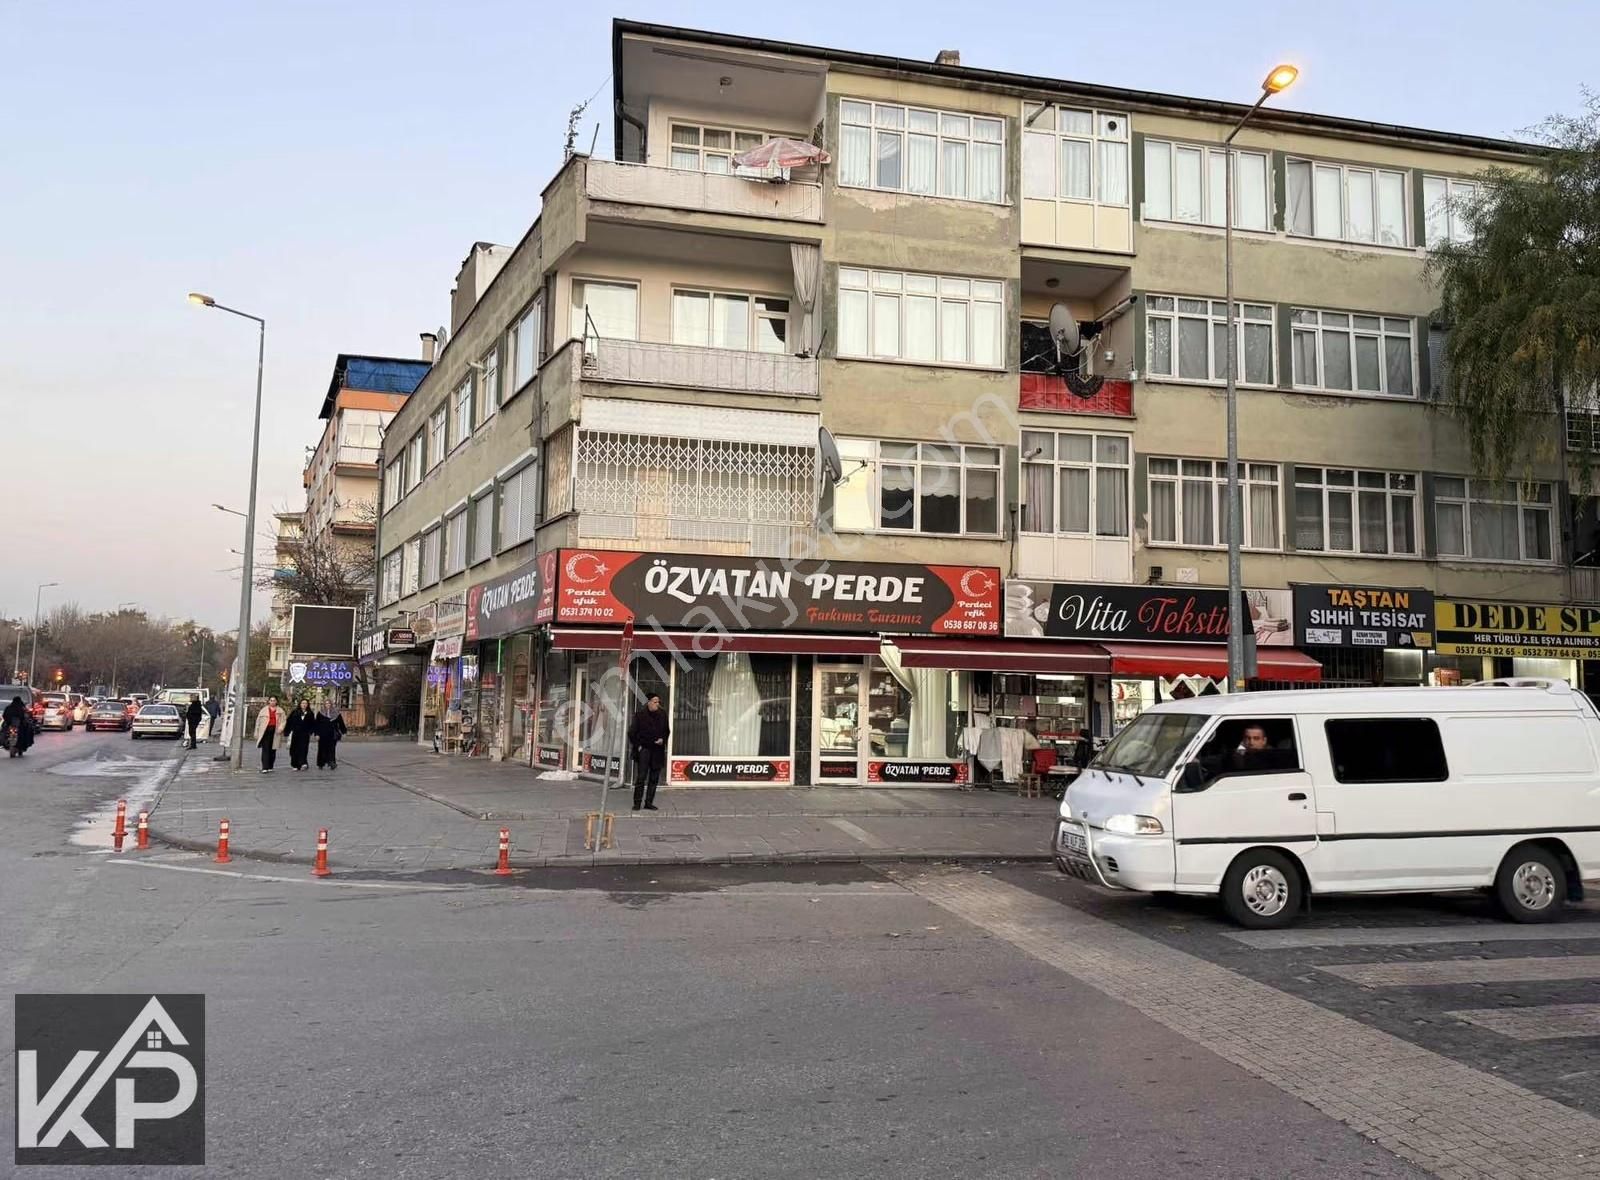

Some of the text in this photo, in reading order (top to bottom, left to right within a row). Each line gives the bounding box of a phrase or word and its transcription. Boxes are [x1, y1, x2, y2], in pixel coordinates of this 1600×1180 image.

[645, 559, 925, 604] ÖZVATAN PERDE
[481, 583, 510, 619] ÖZVATAN
[510, 571, 537, 604] PERDE
[1327, 589, 1409, 609] TAŞTAN
[603, 608, 614, 617] 02
[1059, 594, 1131, 632] Vita
[1310, 607, 1426, 628] SIHHİ TESİSAT
[1453, 603, 1547, 631] DEDE
[943, 620, 998, 631] 0538 687 08 36
[1474, 634, 1491, 643] HER
[1492, 632, 1521, 644] TÜRLÜ
[1522, 635, 1540, 645] 2.EL
[1541, 636, 1562, 647] EŞYA
[1455, 645, 1475, 654] 0537
[1522, 649, 1542, 657] 0532
[692, 762, 769, 775] ÖZVATAN PERDE
[885, 763, 951, 776] ÖZVATAN PERDE
